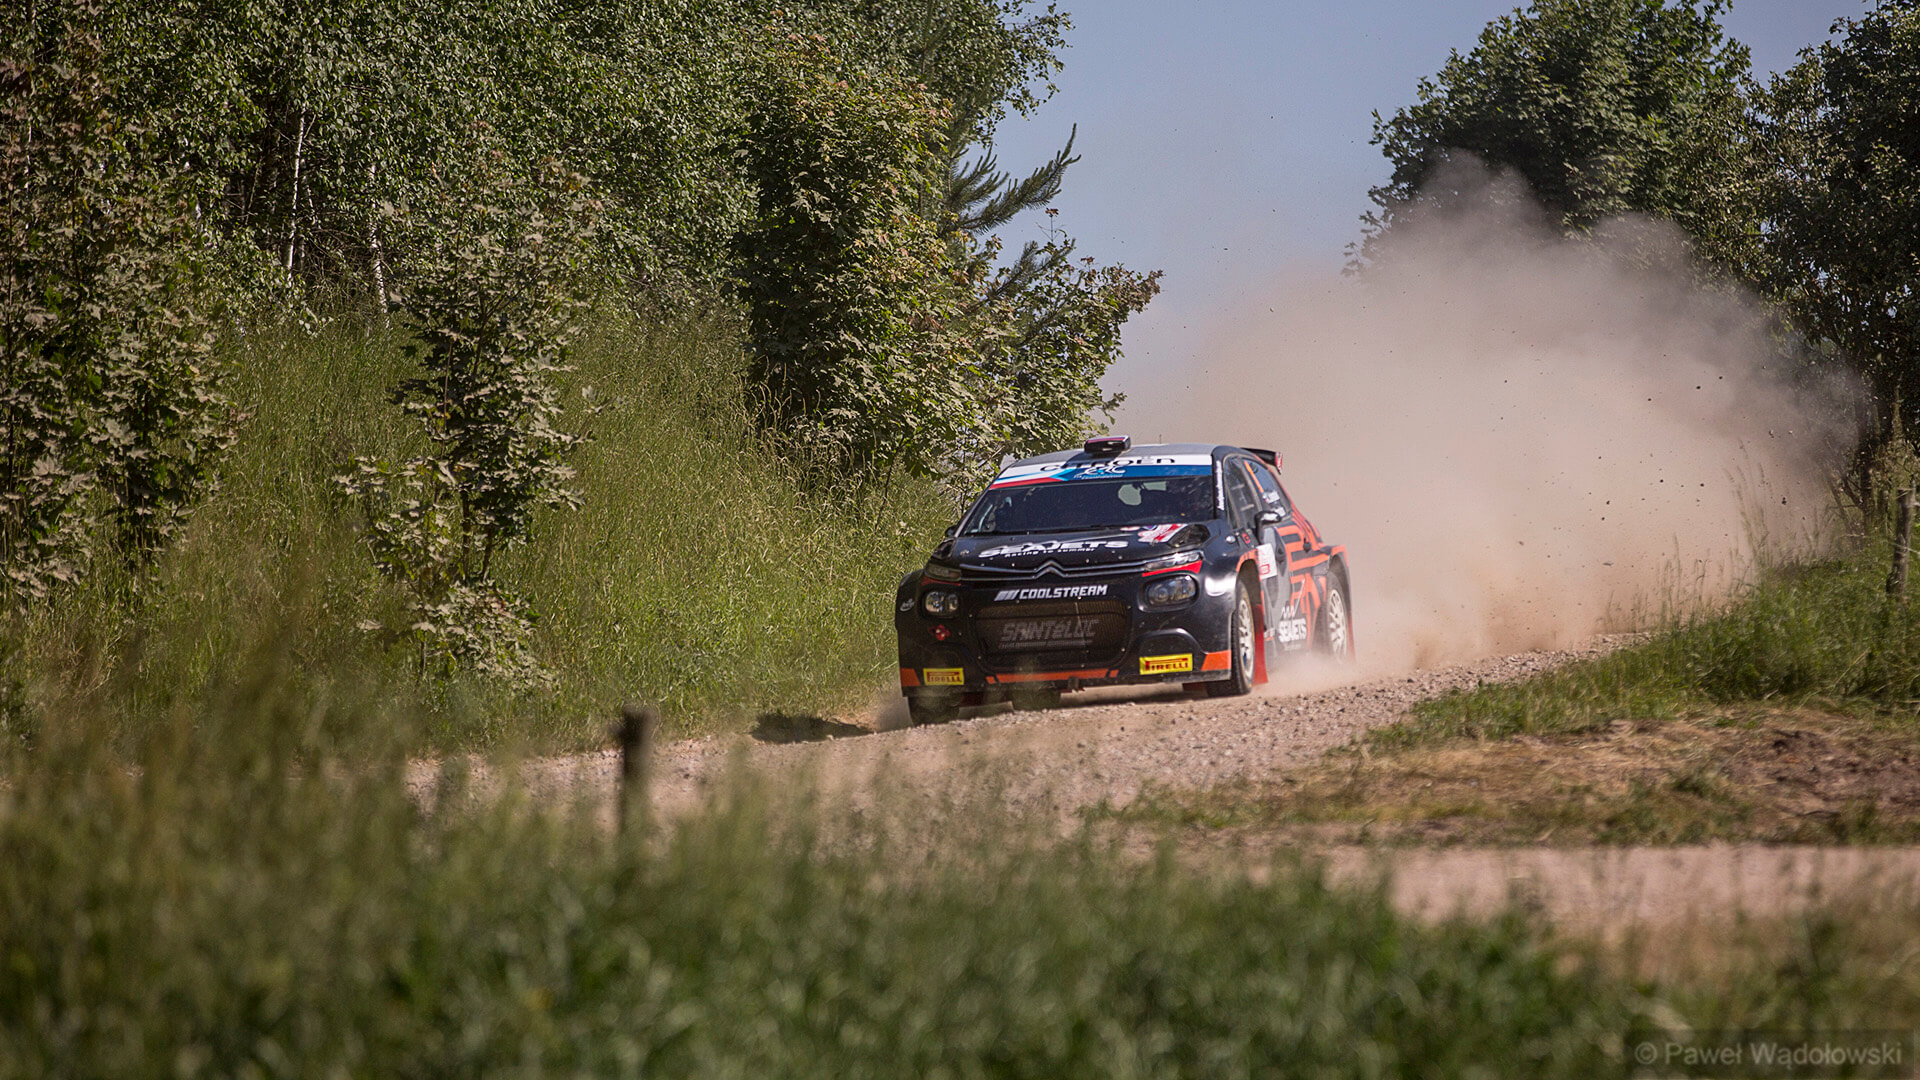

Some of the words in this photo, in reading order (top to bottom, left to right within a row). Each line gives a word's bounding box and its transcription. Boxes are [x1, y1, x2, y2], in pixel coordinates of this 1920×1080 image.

[978, 540, 1129, 558] SEAJETS
[1018, 584, 1108, 600] COOLSTREAM
[1278, 618, 1307, 643] SEAJETS
[1145, 657, 1188, 672] PIRELLI
[926, 671, 962, 683] PIRELLI
